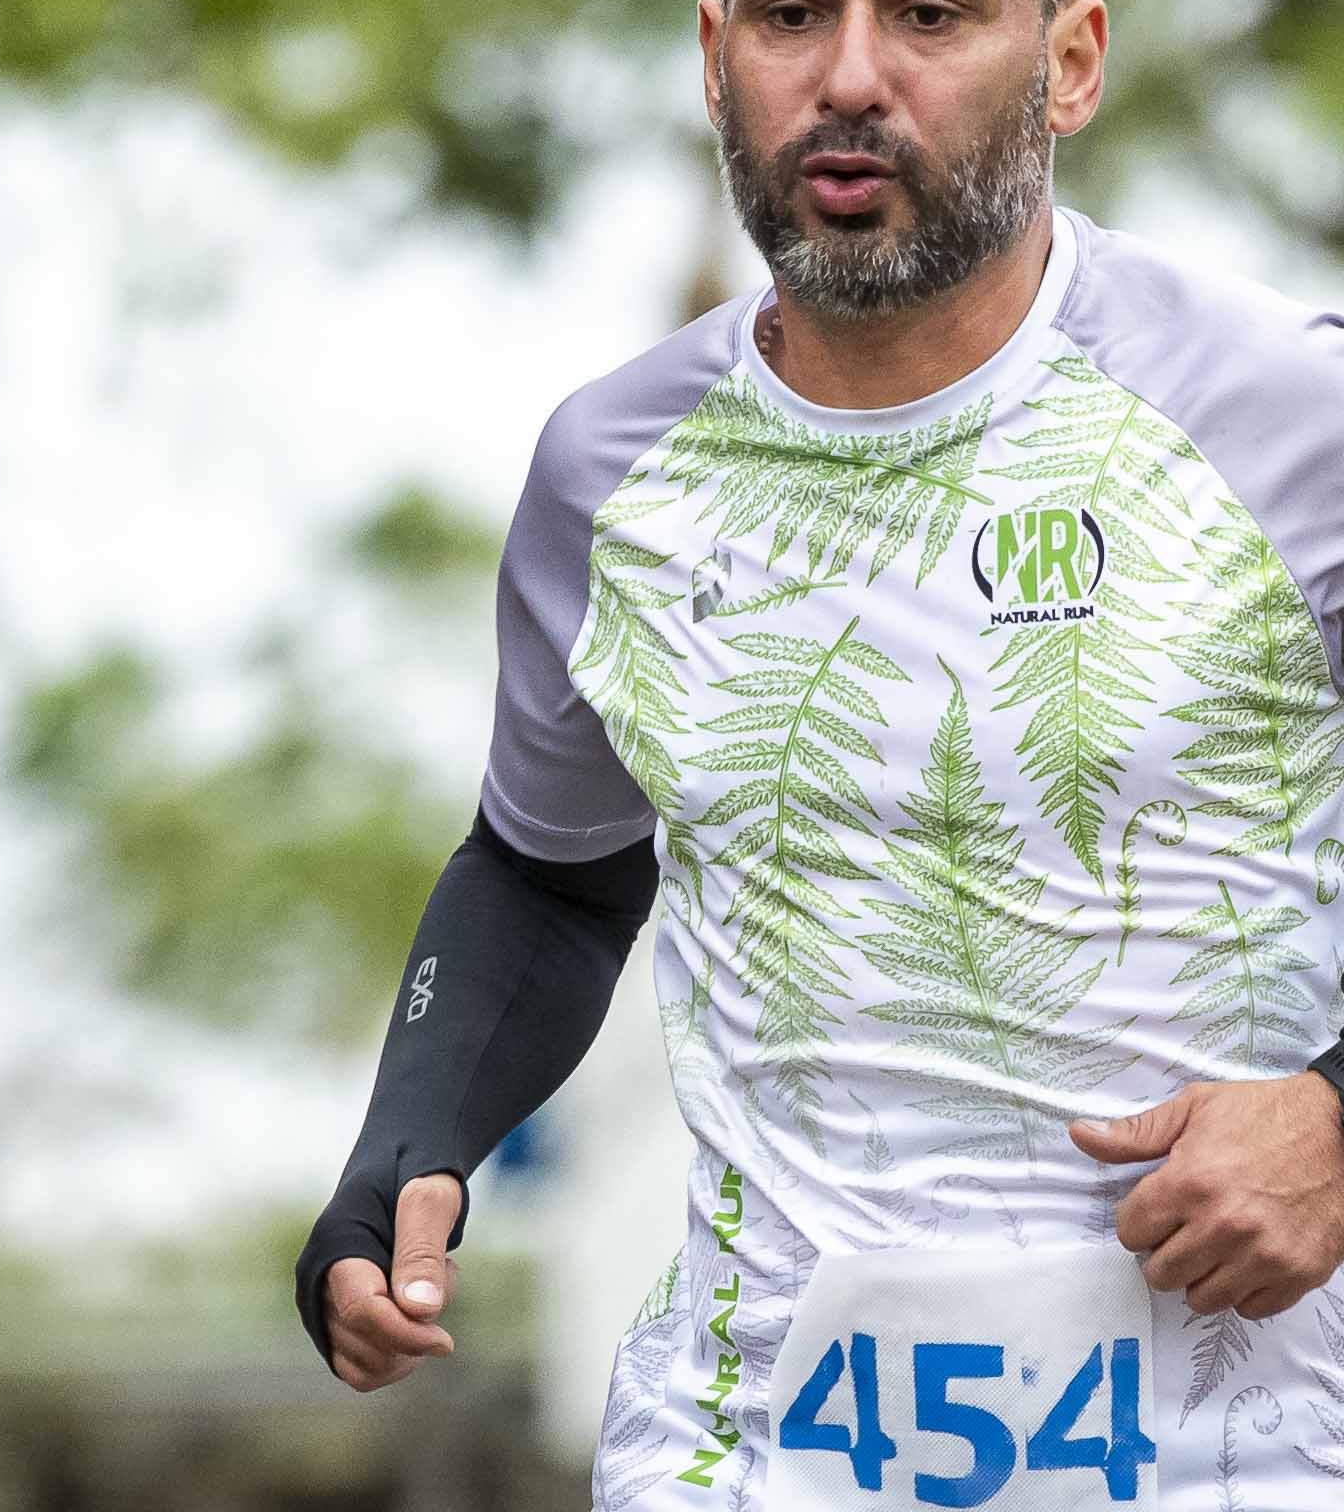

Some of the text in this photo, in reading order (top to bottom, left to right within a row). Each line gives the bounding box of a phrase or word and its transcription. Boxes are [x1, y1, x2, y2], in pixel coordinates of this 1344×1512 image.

[990, 605, 1095, 626] NATURAL RUN
[406, 955, 438, 1024] EXO
[778, 1331, 1157, 1509] 454
